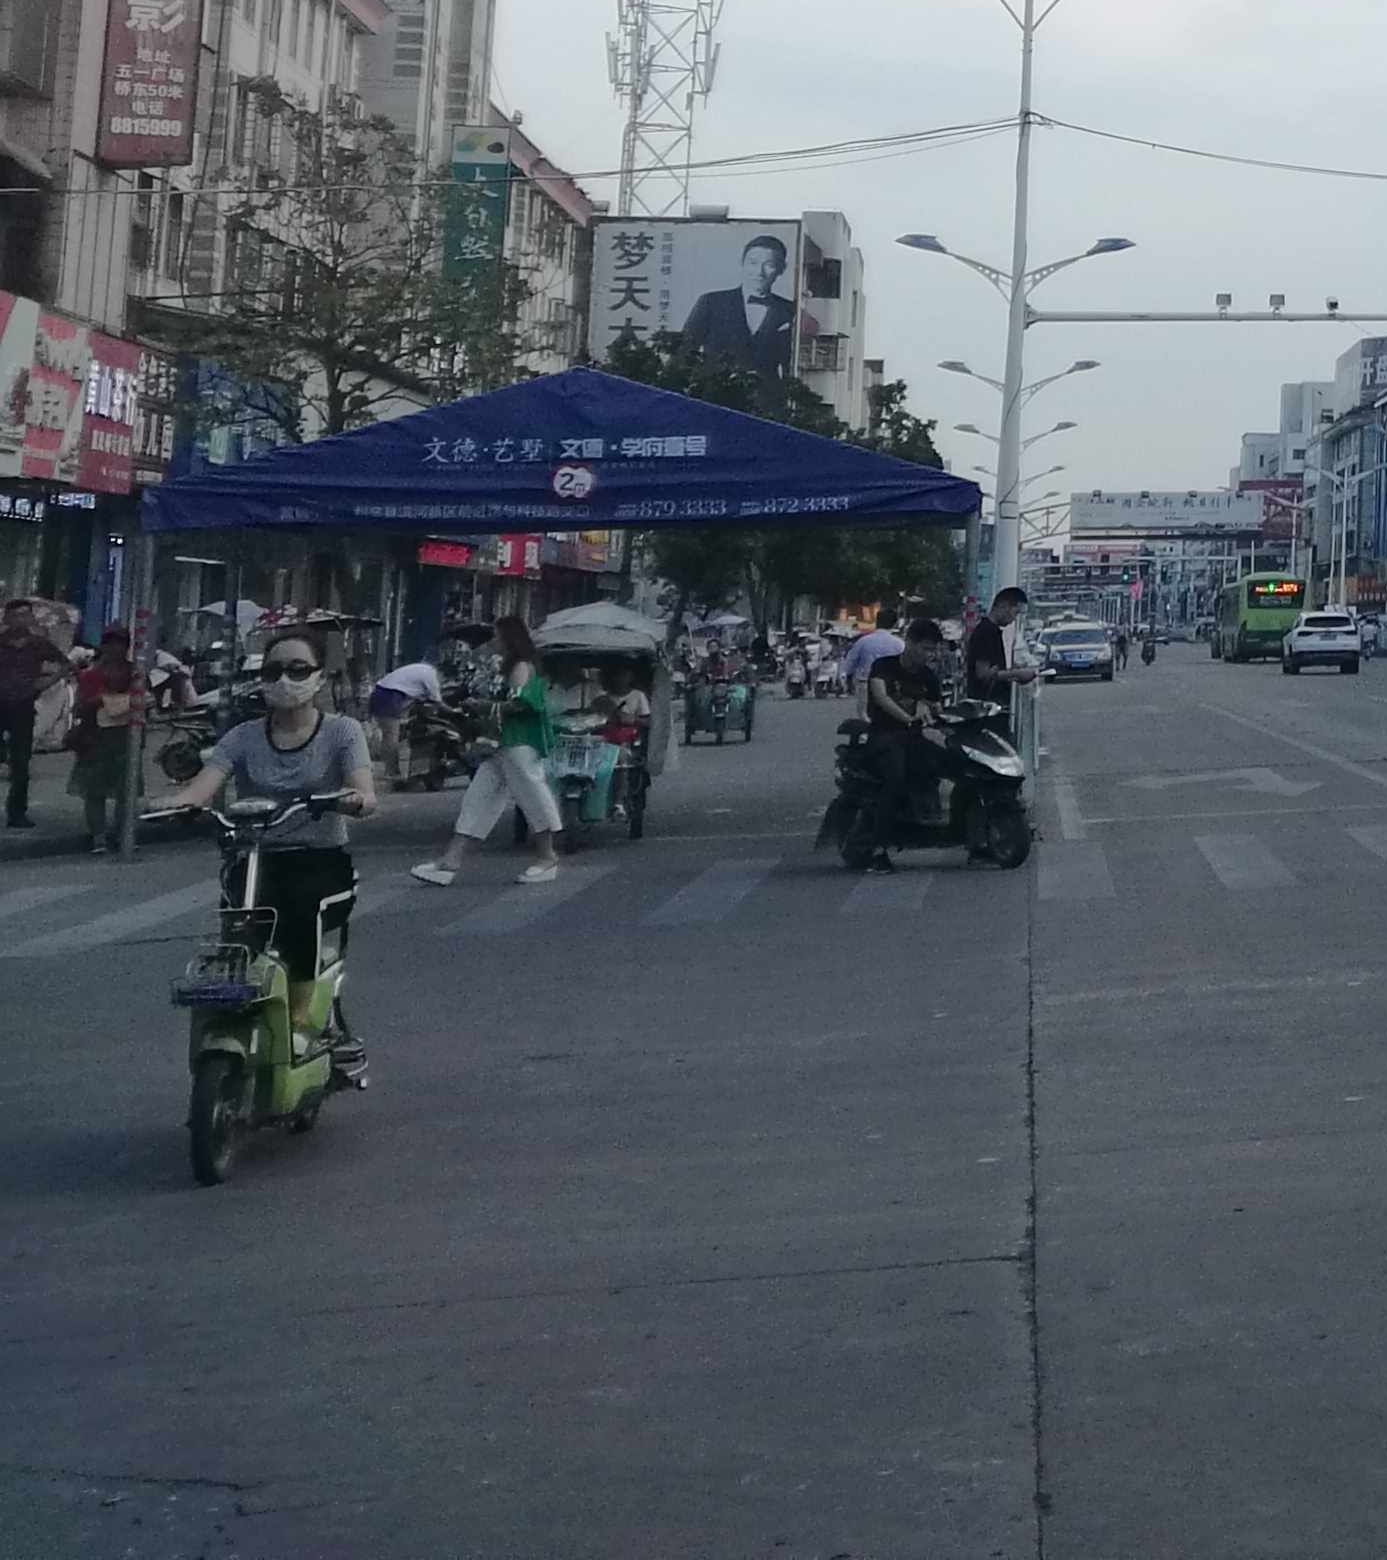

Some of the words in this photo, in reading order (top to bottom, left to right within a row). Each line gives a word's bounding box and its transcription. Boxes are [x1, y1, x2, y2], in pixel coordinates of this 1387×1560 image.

[115, 64, 185, 83] 五一广场
[114, 81, 184, 99] 桥东50米
[131, 101, 165, 116] 电话
[111, 117, 182, 137] 8815999
